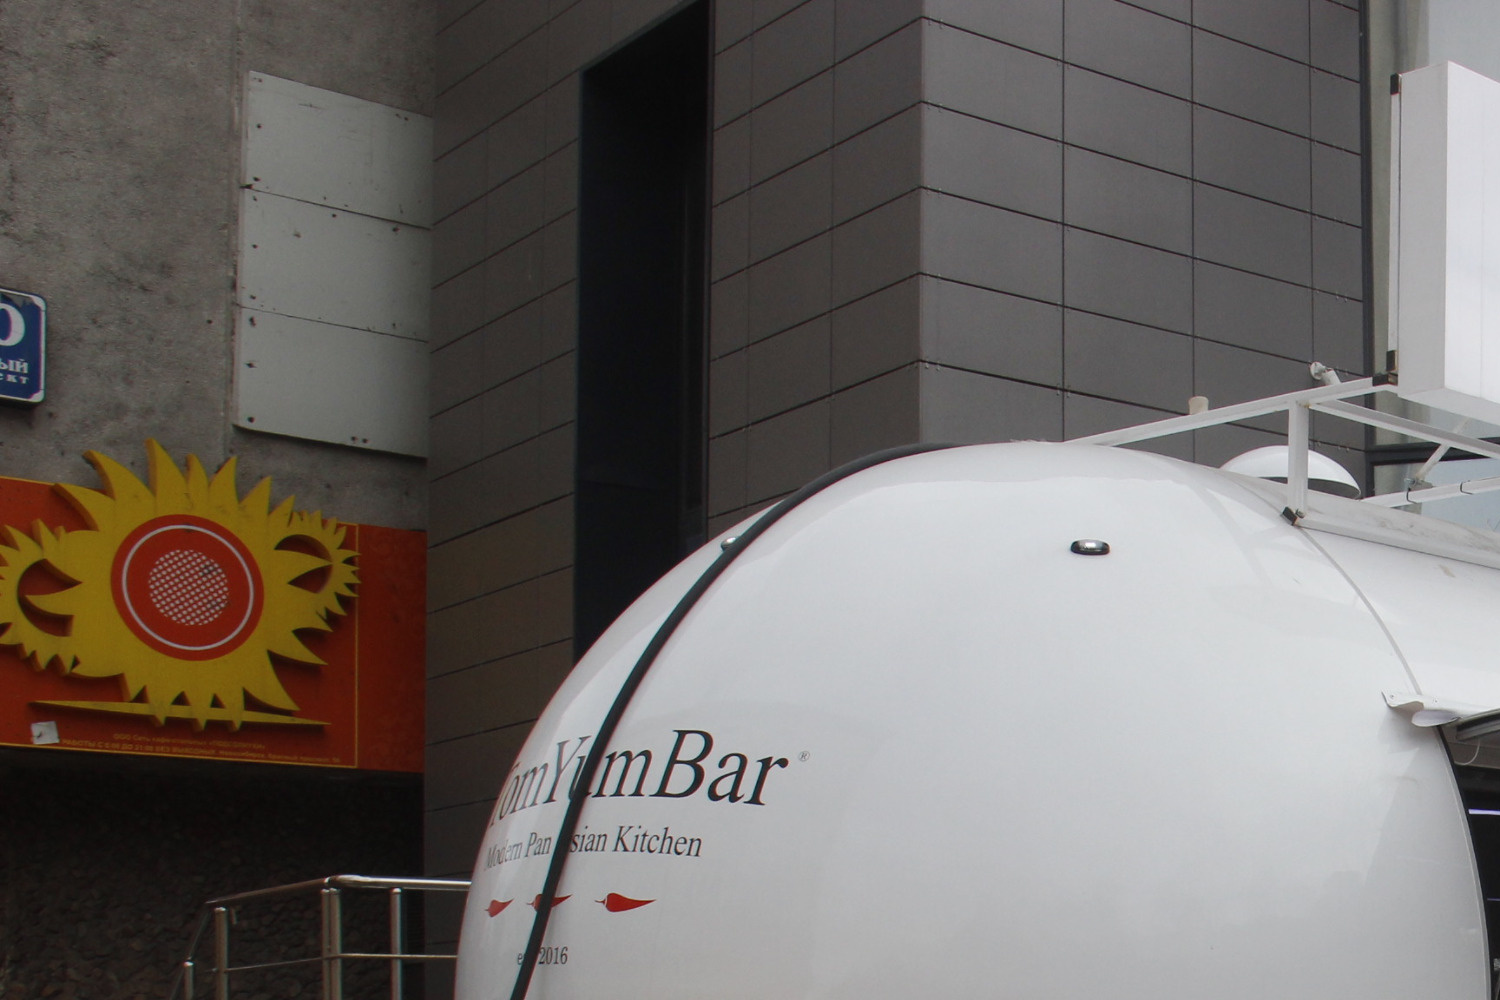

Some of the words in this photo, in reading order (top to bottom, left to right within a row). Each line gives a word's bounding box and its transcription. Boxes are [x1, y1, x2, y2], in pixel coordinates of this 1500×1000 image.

[525, 832, 552, 857] Pan
[569, 826, 607, 853] sian
[612, 825, 702, 857] Kitchen
[538, 946, 568, 965] 2016
